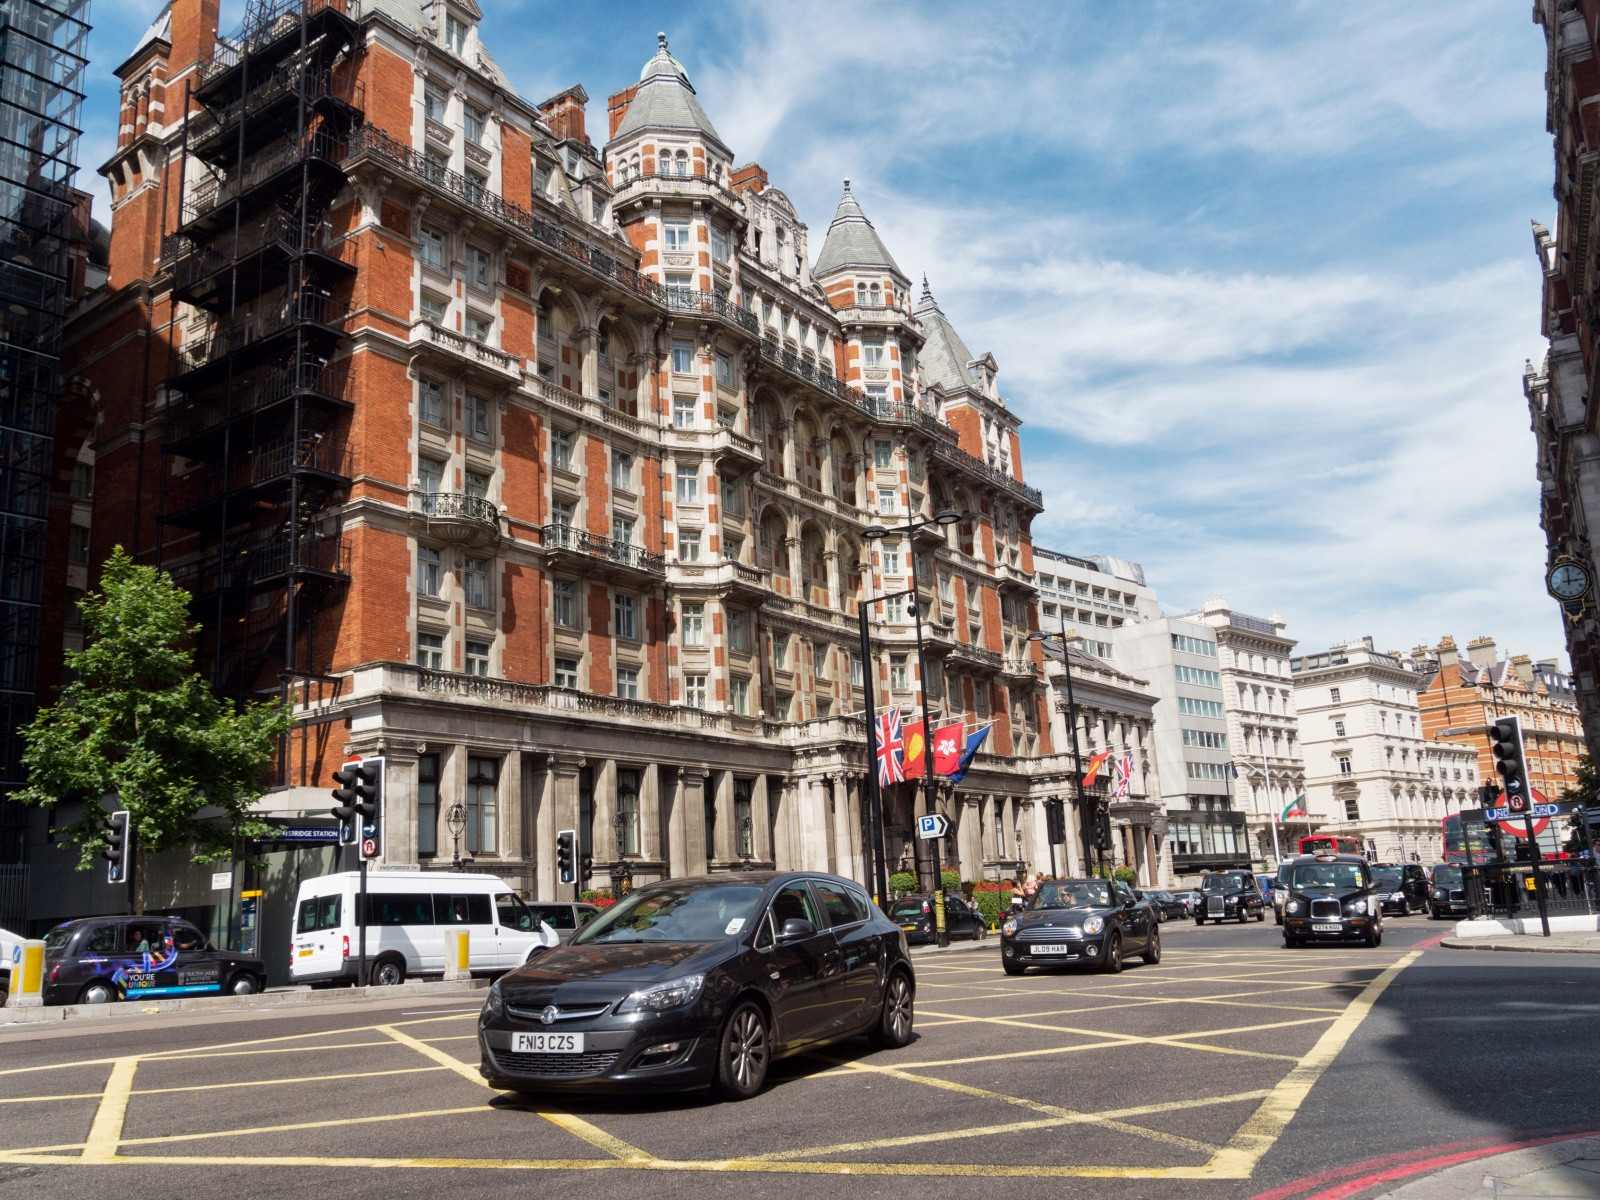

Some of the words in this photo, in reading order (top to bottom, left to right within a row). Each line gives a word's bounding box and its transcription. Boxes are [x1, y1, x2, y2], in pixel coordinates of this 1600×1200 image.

[1486, 804, 1558, 820] UNDUND
[924, 818, 932, 830] P
[1033, 945, 1050, 953] JL09
[1051, 945, 1065, 953] HAR
[128, 973, 155, 981] YOU'RE
[128, 980, 156, 988] UNIQUE
[519, 1035, 544, 1050] FN13
[548, 1035, 574, 1050] CZS
